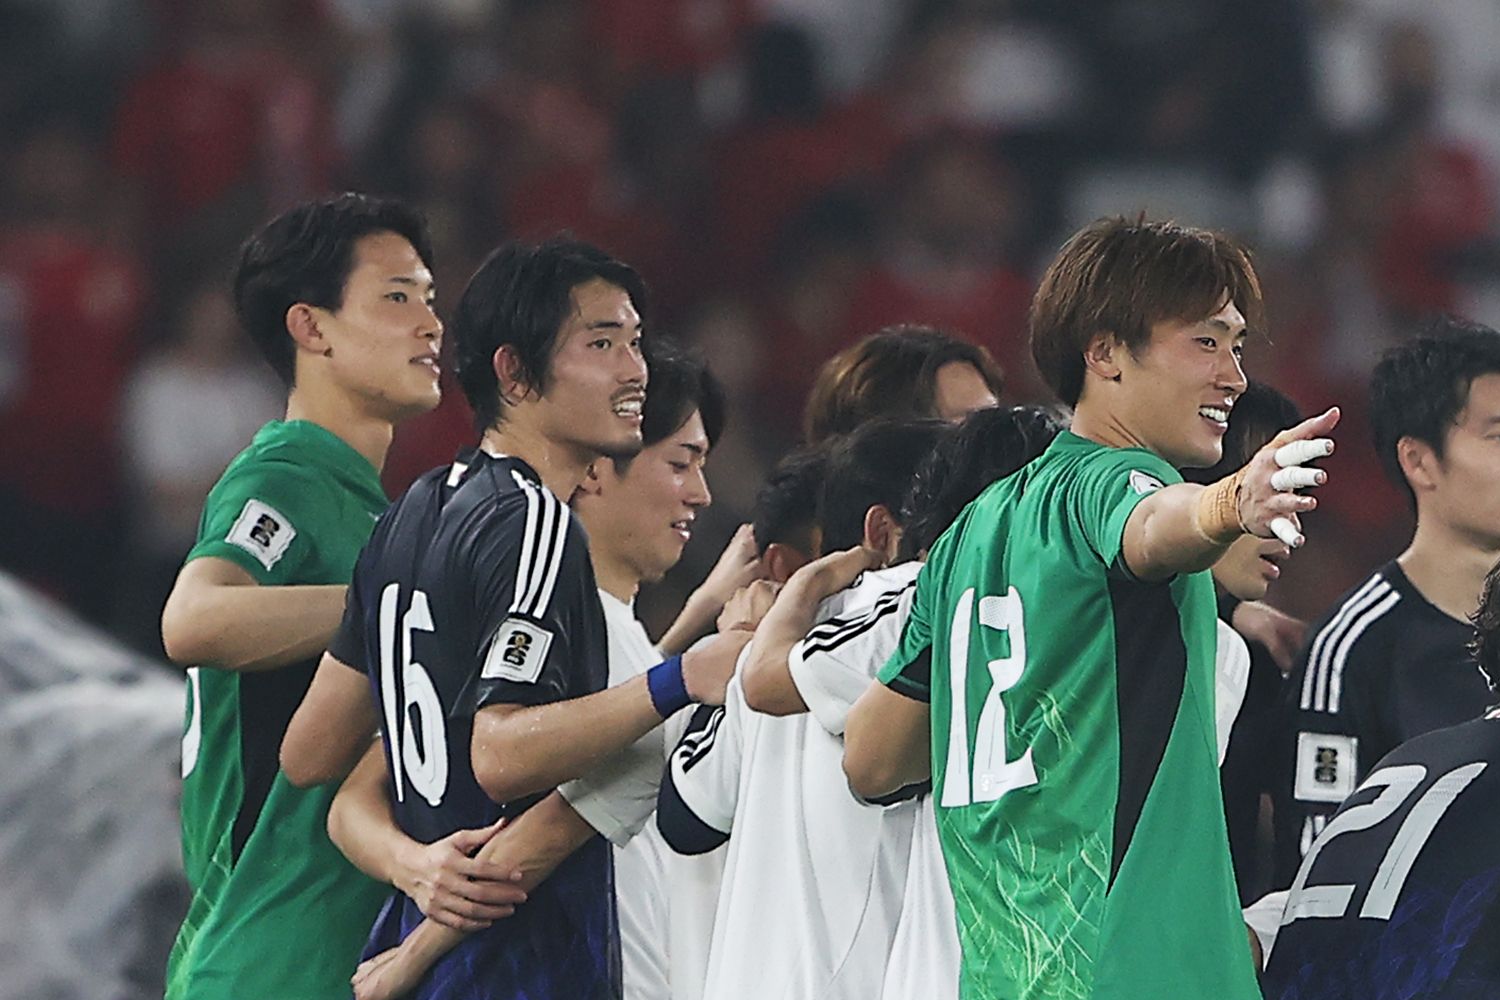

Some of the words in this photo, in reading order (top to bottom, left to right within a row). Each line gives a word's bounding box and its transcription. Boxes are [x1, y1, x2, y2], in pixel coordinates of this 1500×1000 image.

[379, 583, 448, 807] 16
[941, 585, 1038, 807] 12
[1279, 762, 1488, 927] 21
